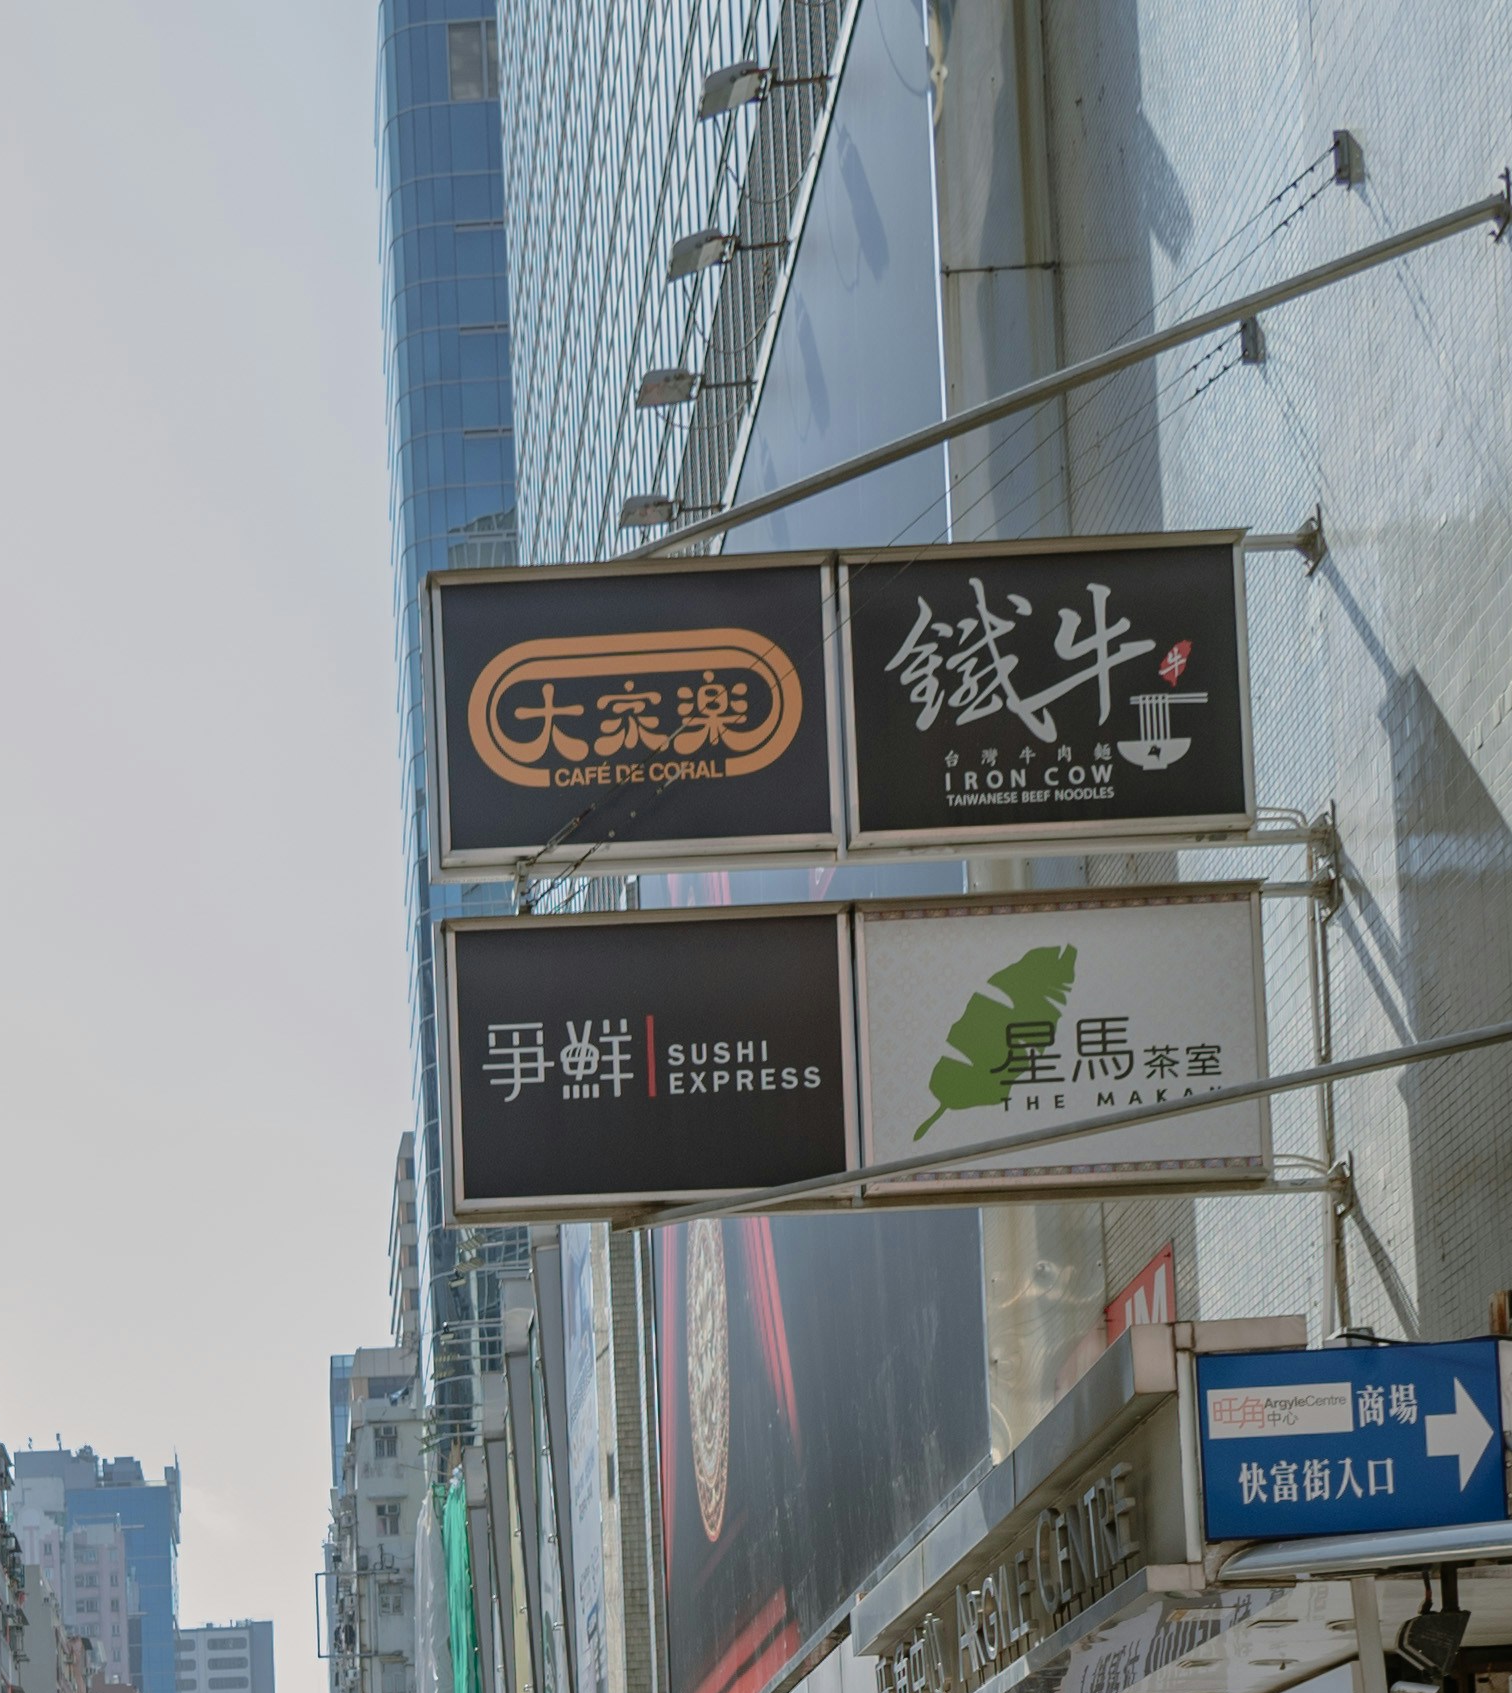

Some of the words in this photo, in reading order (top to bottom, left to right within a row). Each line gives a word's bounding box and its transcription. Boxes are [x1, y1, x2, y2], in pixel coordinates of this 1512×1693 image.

[884, 577, 1156, 743] 鐵牛
[554, 761, 611, 787] CAFÉ
[616, 762, 645, 785] DE
[649, 759, 724, 781] CORAL
[945, 768, 1026, 791] IRON
[1044, 764, 1113, 787] COW
[946, 792, 1018, 807] TAIWANESE
[1022, 790, 1051, 803] BEEF
[1054, 786, 1115, 801] NOODLES
[482, 1018, 634, 1102] 爭鮮
[667, 1040, 768, 1066] SUSHI
[669, 1066, 822, 1095] EXPRESS
[1000, 1095, 1066, 1112] THE
[1097, 1086, 1222, 1107] MAK
[1267, 1411, 1298, 1427] 中心
[1356, 1383, 1419, 1428] 商場
[1238, 1457, 1396, 1505] 快富街入口
[956, 1549, 1039, 1683] ARGYLE
[1036, 1462, 1141, 1615] CENTRE
